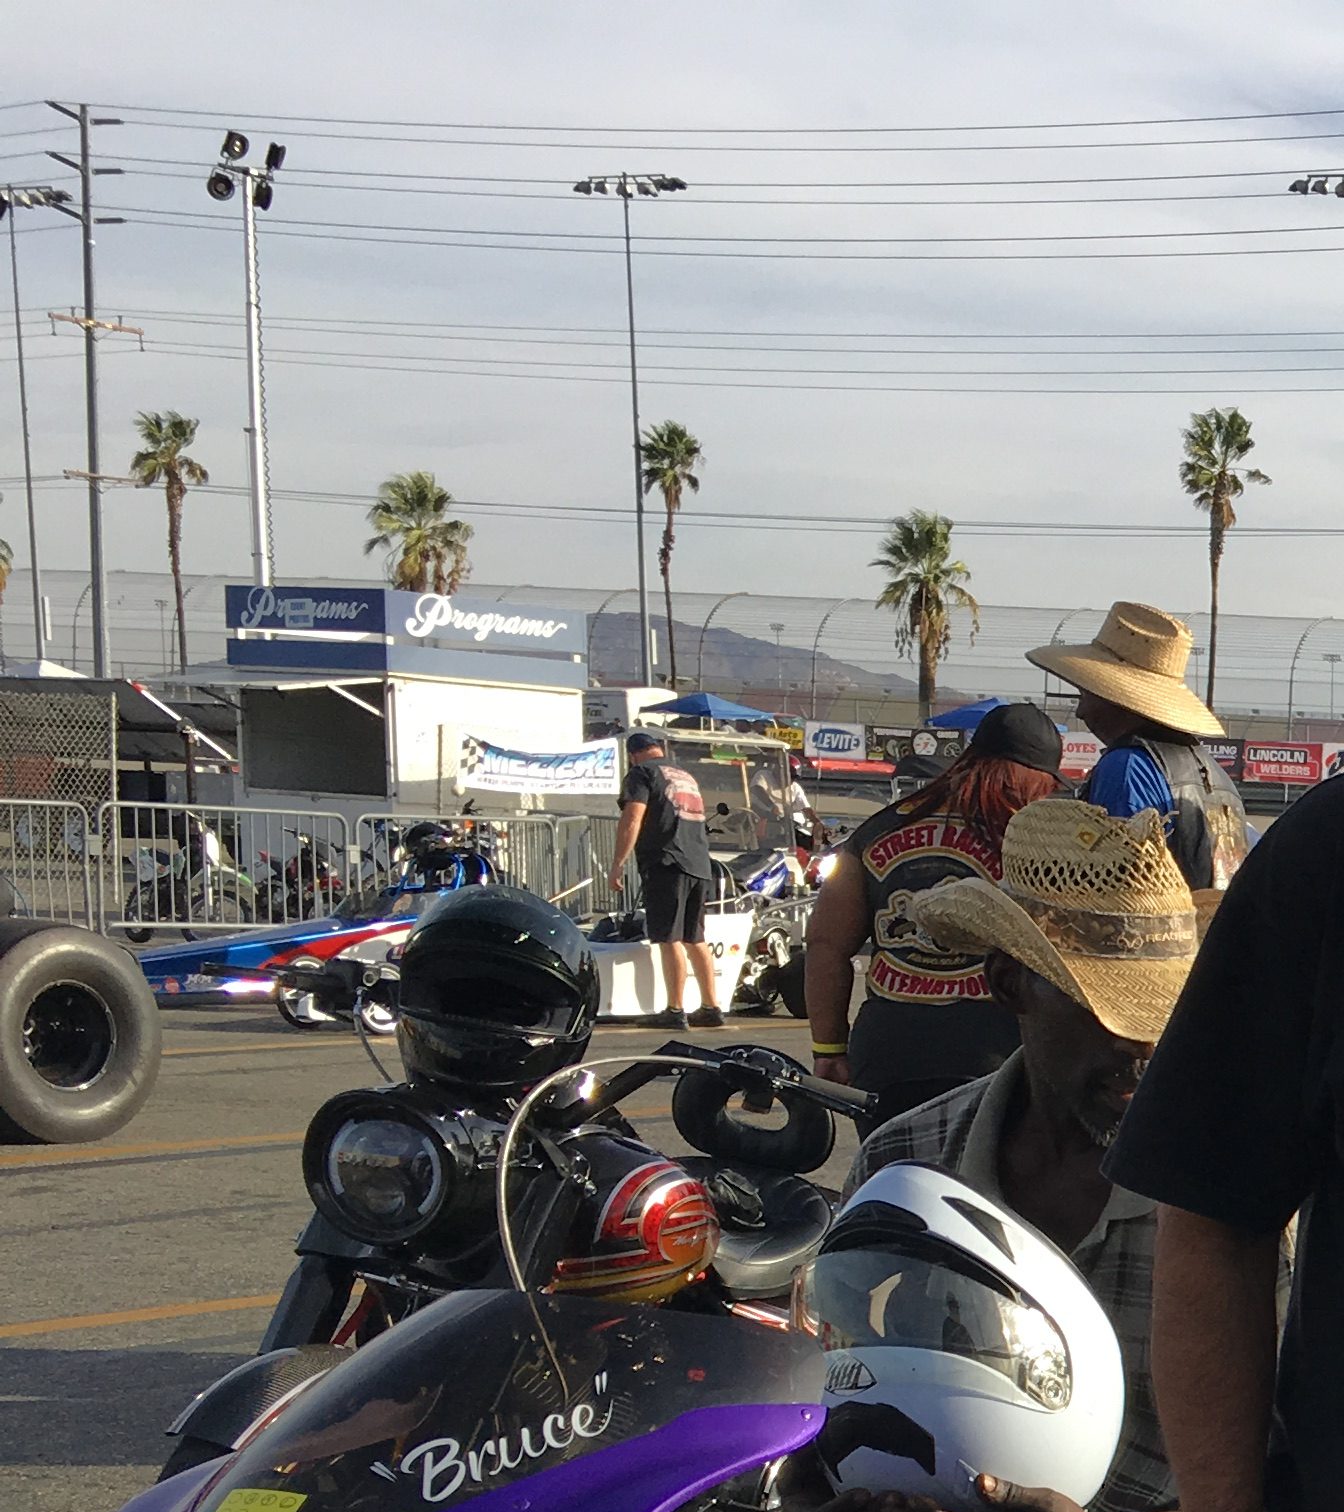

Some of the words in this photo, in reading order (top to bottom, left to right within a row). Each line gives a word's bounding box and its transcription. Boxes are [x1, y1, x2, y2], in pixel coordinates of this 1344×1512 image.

[405, 592, 568, 642] Programs
[811, 730, 860, 750] CLEVITE
[1249, 748, 1305, 763] LINCOLN
[1260, 763, 1310, 777] WELDERS
[869, 825, 938, 869] STREET
